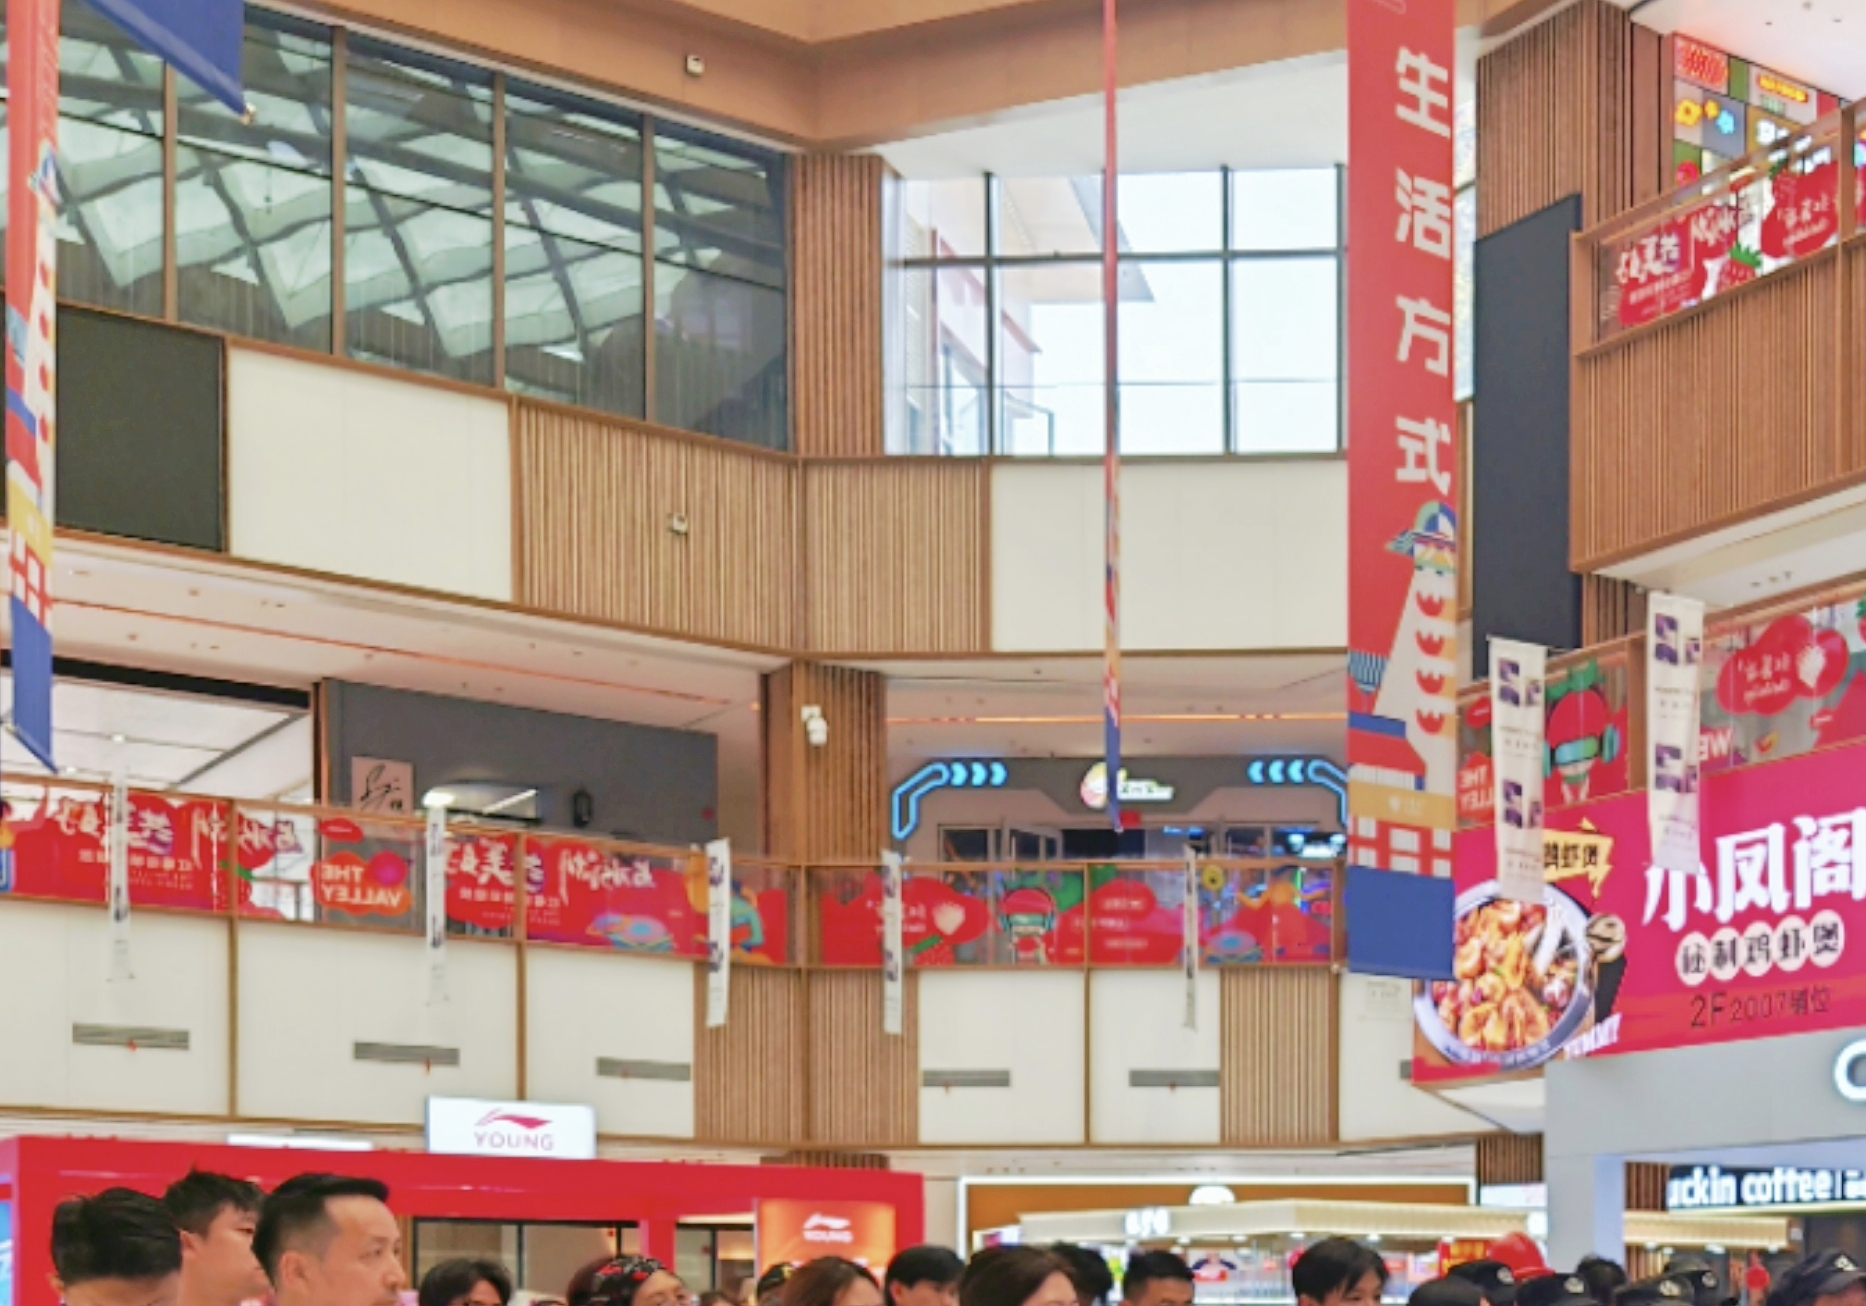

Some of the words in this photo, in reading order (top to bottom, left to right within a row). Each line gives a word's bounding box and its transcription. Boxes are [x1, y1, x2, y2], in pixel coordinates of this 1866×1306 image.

[1396, 46, 1453, 496] 生活方式
[473, 1131, 555, 1151] YOUNG
[1741, 1166, 1831, 1202] coffee
